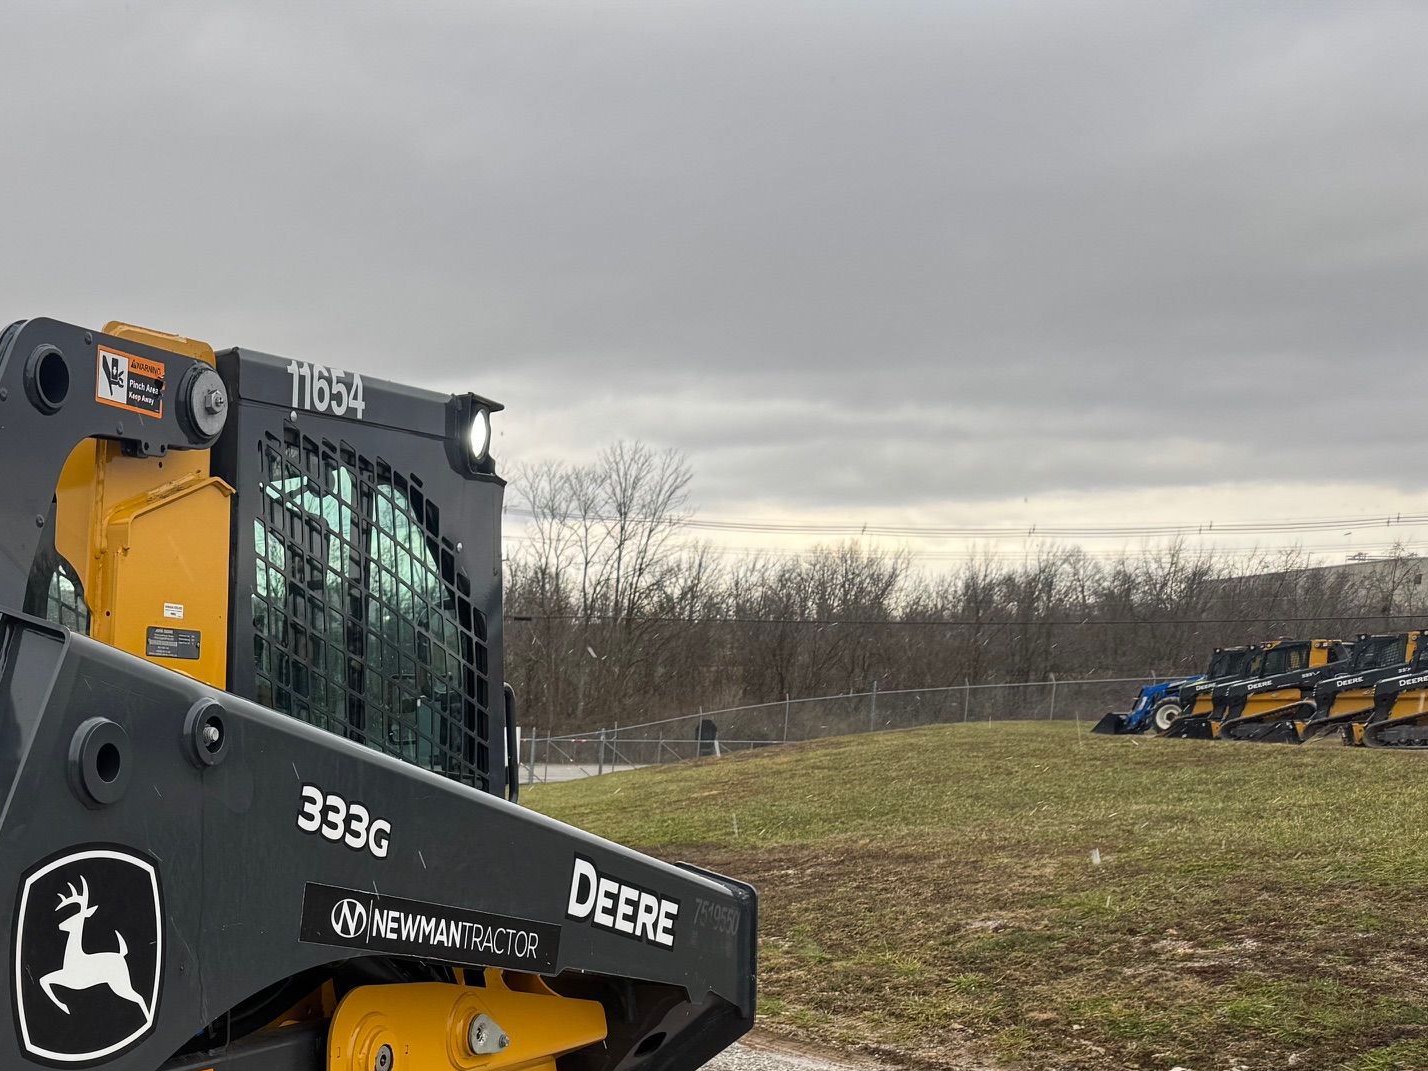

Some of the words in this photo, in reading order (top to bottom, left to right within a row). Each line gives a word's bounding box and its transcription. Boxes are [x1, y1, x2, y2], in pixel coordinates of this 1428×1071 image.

[129, 380, 146, 391] Pinch
[146, 384, 159, 395] Area
[287, 360, 365, 419] 11654
[128, 391, 142, 402] Keep
[142, 395, 155, 406] Away
[1248, 680, 1273, 690] DEERE
[1337, 677, 1364, 687] DEERE
[1399, 675, 1428, 686] DEERE
[297, 785, 391, 857] 333G
[568, 858, 679, 946] DEERE
